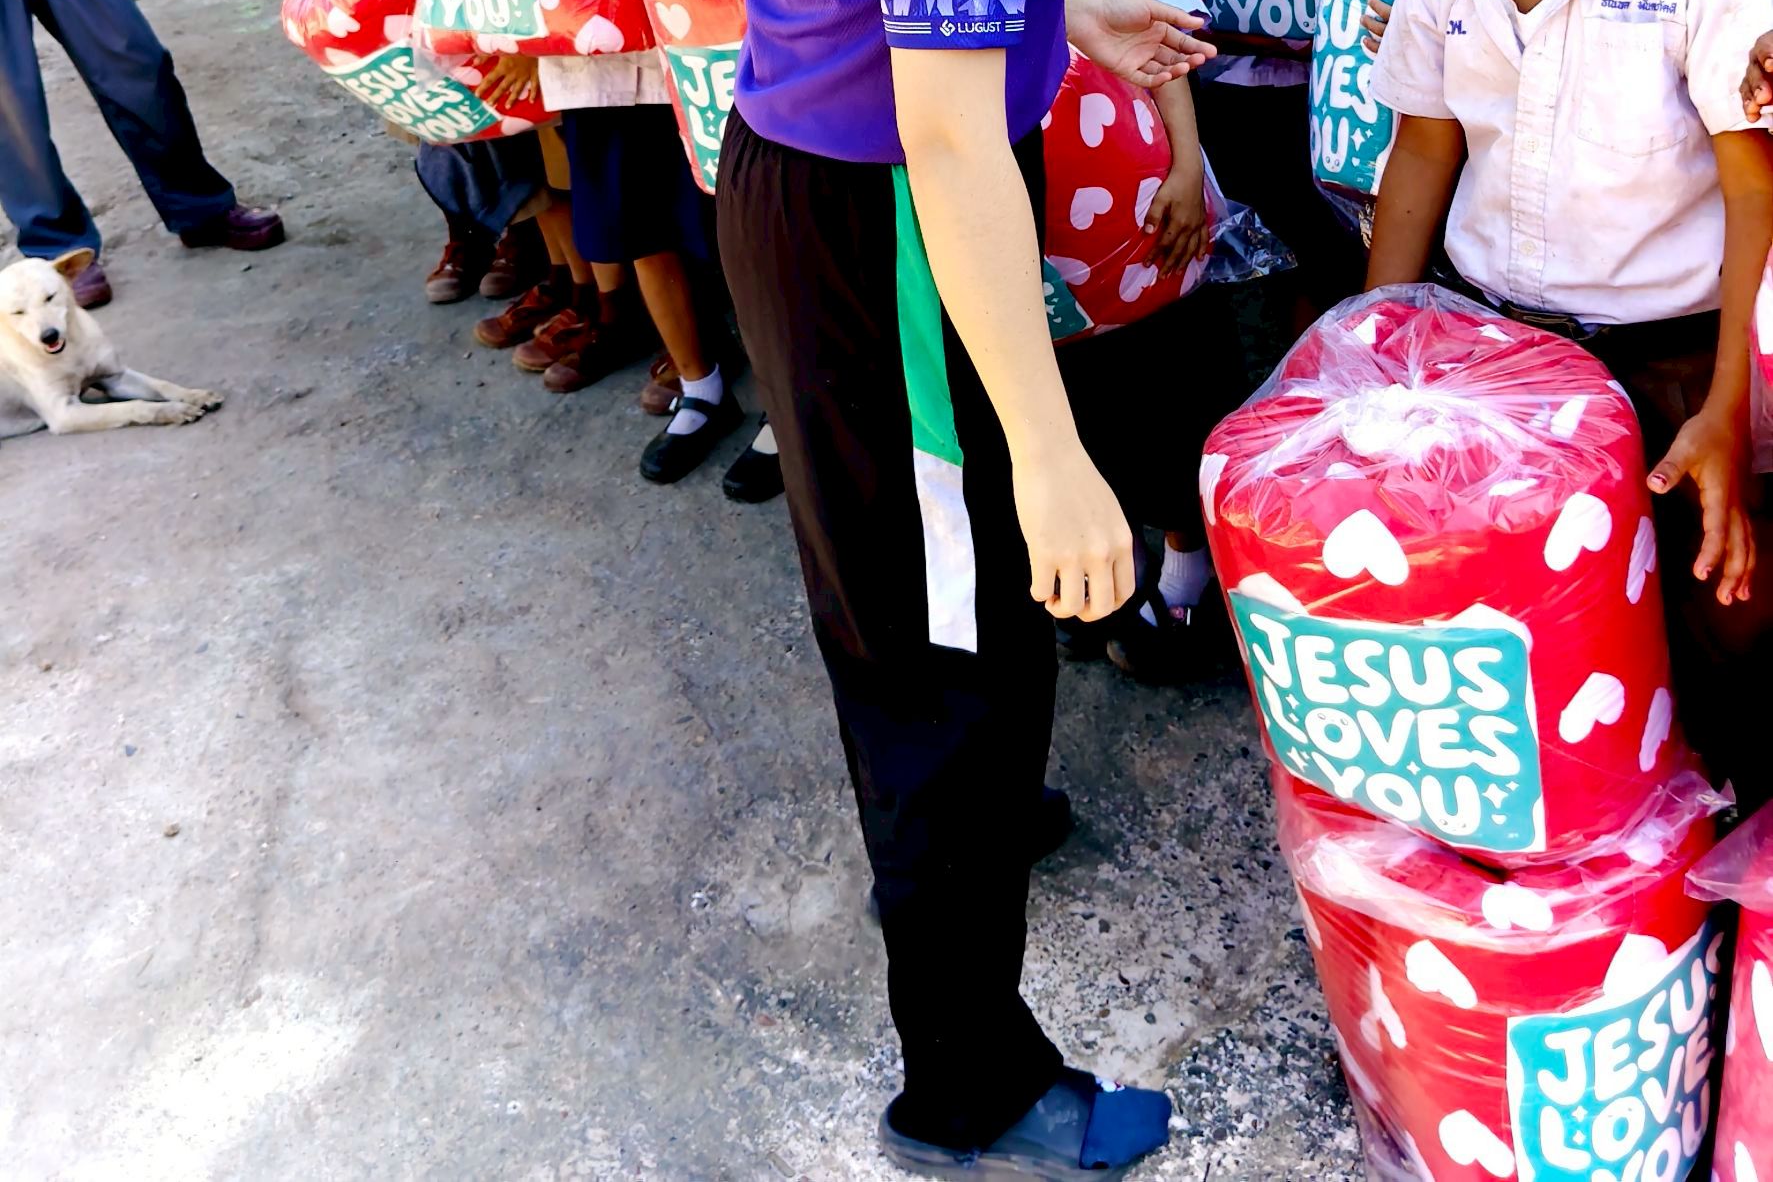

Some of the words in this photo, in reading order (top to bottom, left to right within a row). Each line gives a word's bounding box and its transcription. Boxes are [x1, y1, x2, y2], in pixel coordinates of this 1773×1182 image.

[957, 21, 1002, 34] LUGUST
[1249, 613, 1511, 712] JESUS
[1262, 675, 1521, 777] LOVES
[1310, 750, 1482, 837] YOU
